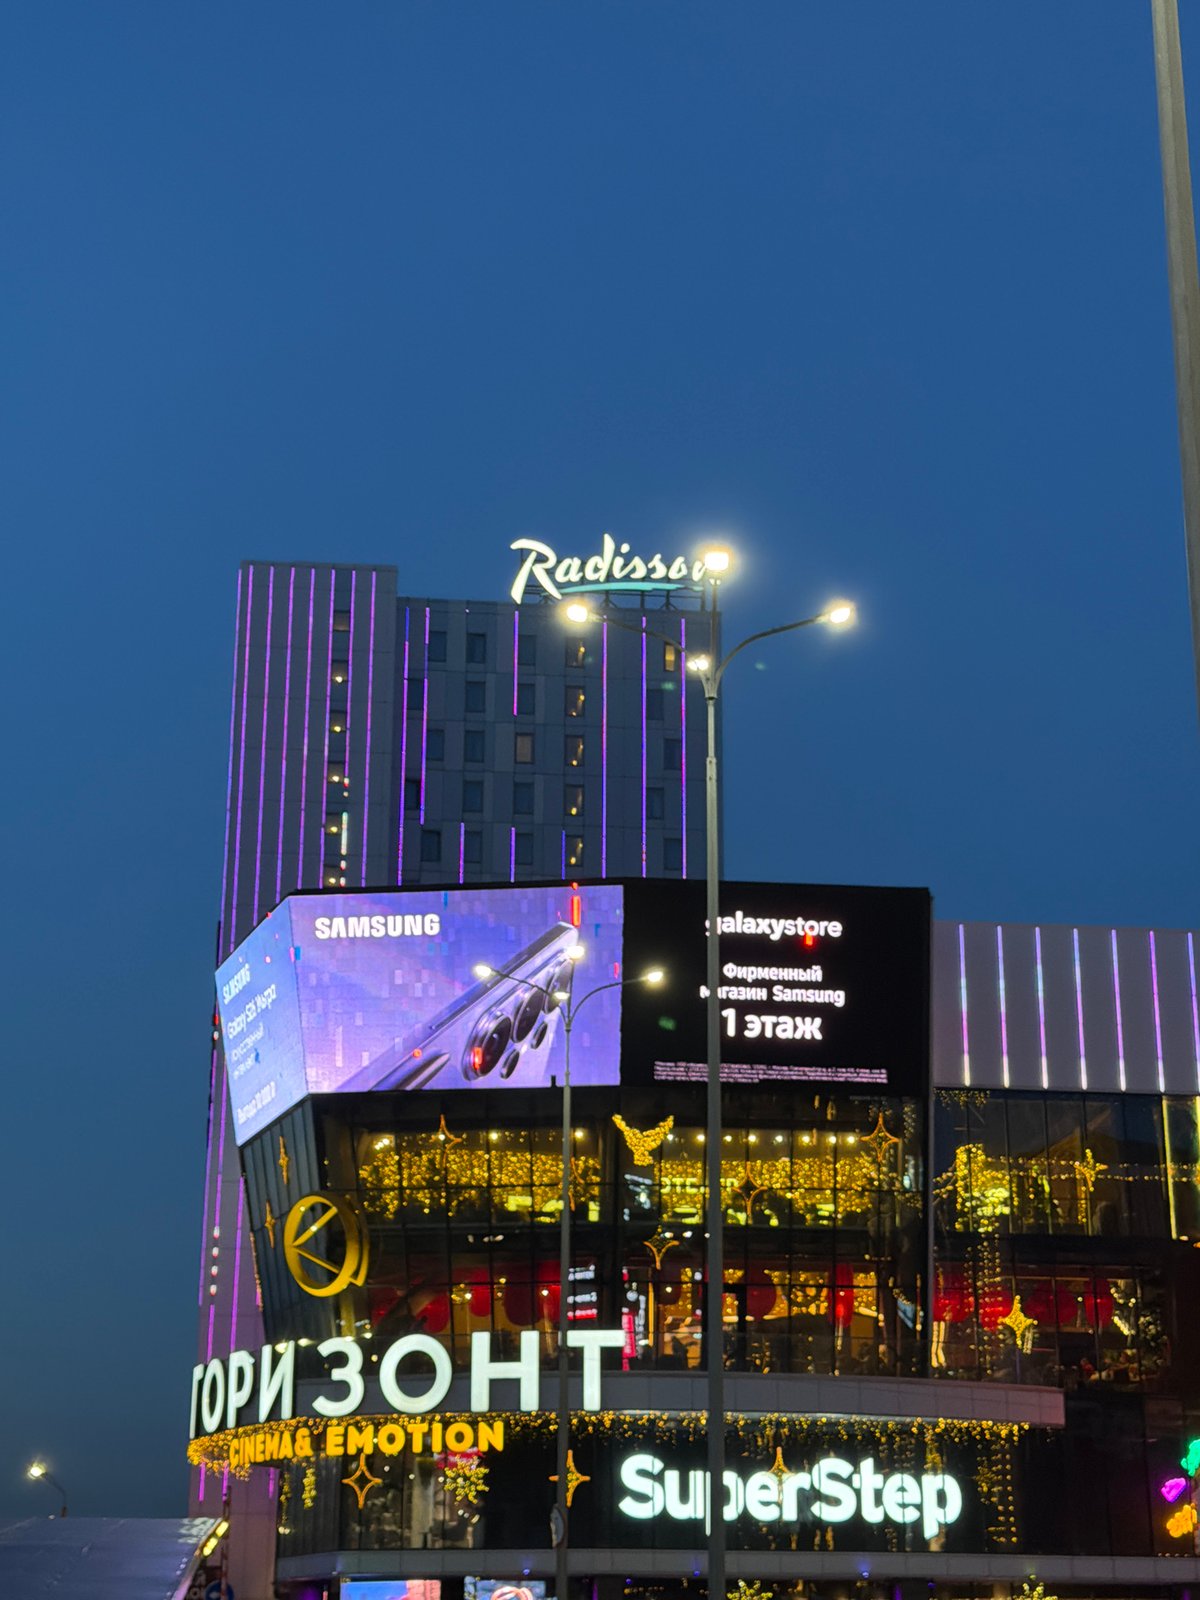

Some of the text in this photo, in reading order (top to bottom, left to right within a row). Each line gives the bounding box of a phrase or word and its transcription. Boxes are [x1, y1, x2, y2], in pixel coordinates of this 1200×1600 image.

[314, 913, 441, 940] SAMSUNG
[722, 962, 823, 983] Фирменный
[772, 985, 846, 1008] Samsung
[721, 1007, 823, 1041] 1 этаж
[189, 1330, 625, 1440] ГОРИЗОНТ
[326, 1420, 504, 1455] EMOTION
[618, 1453, 963, 1539] SuperStep
